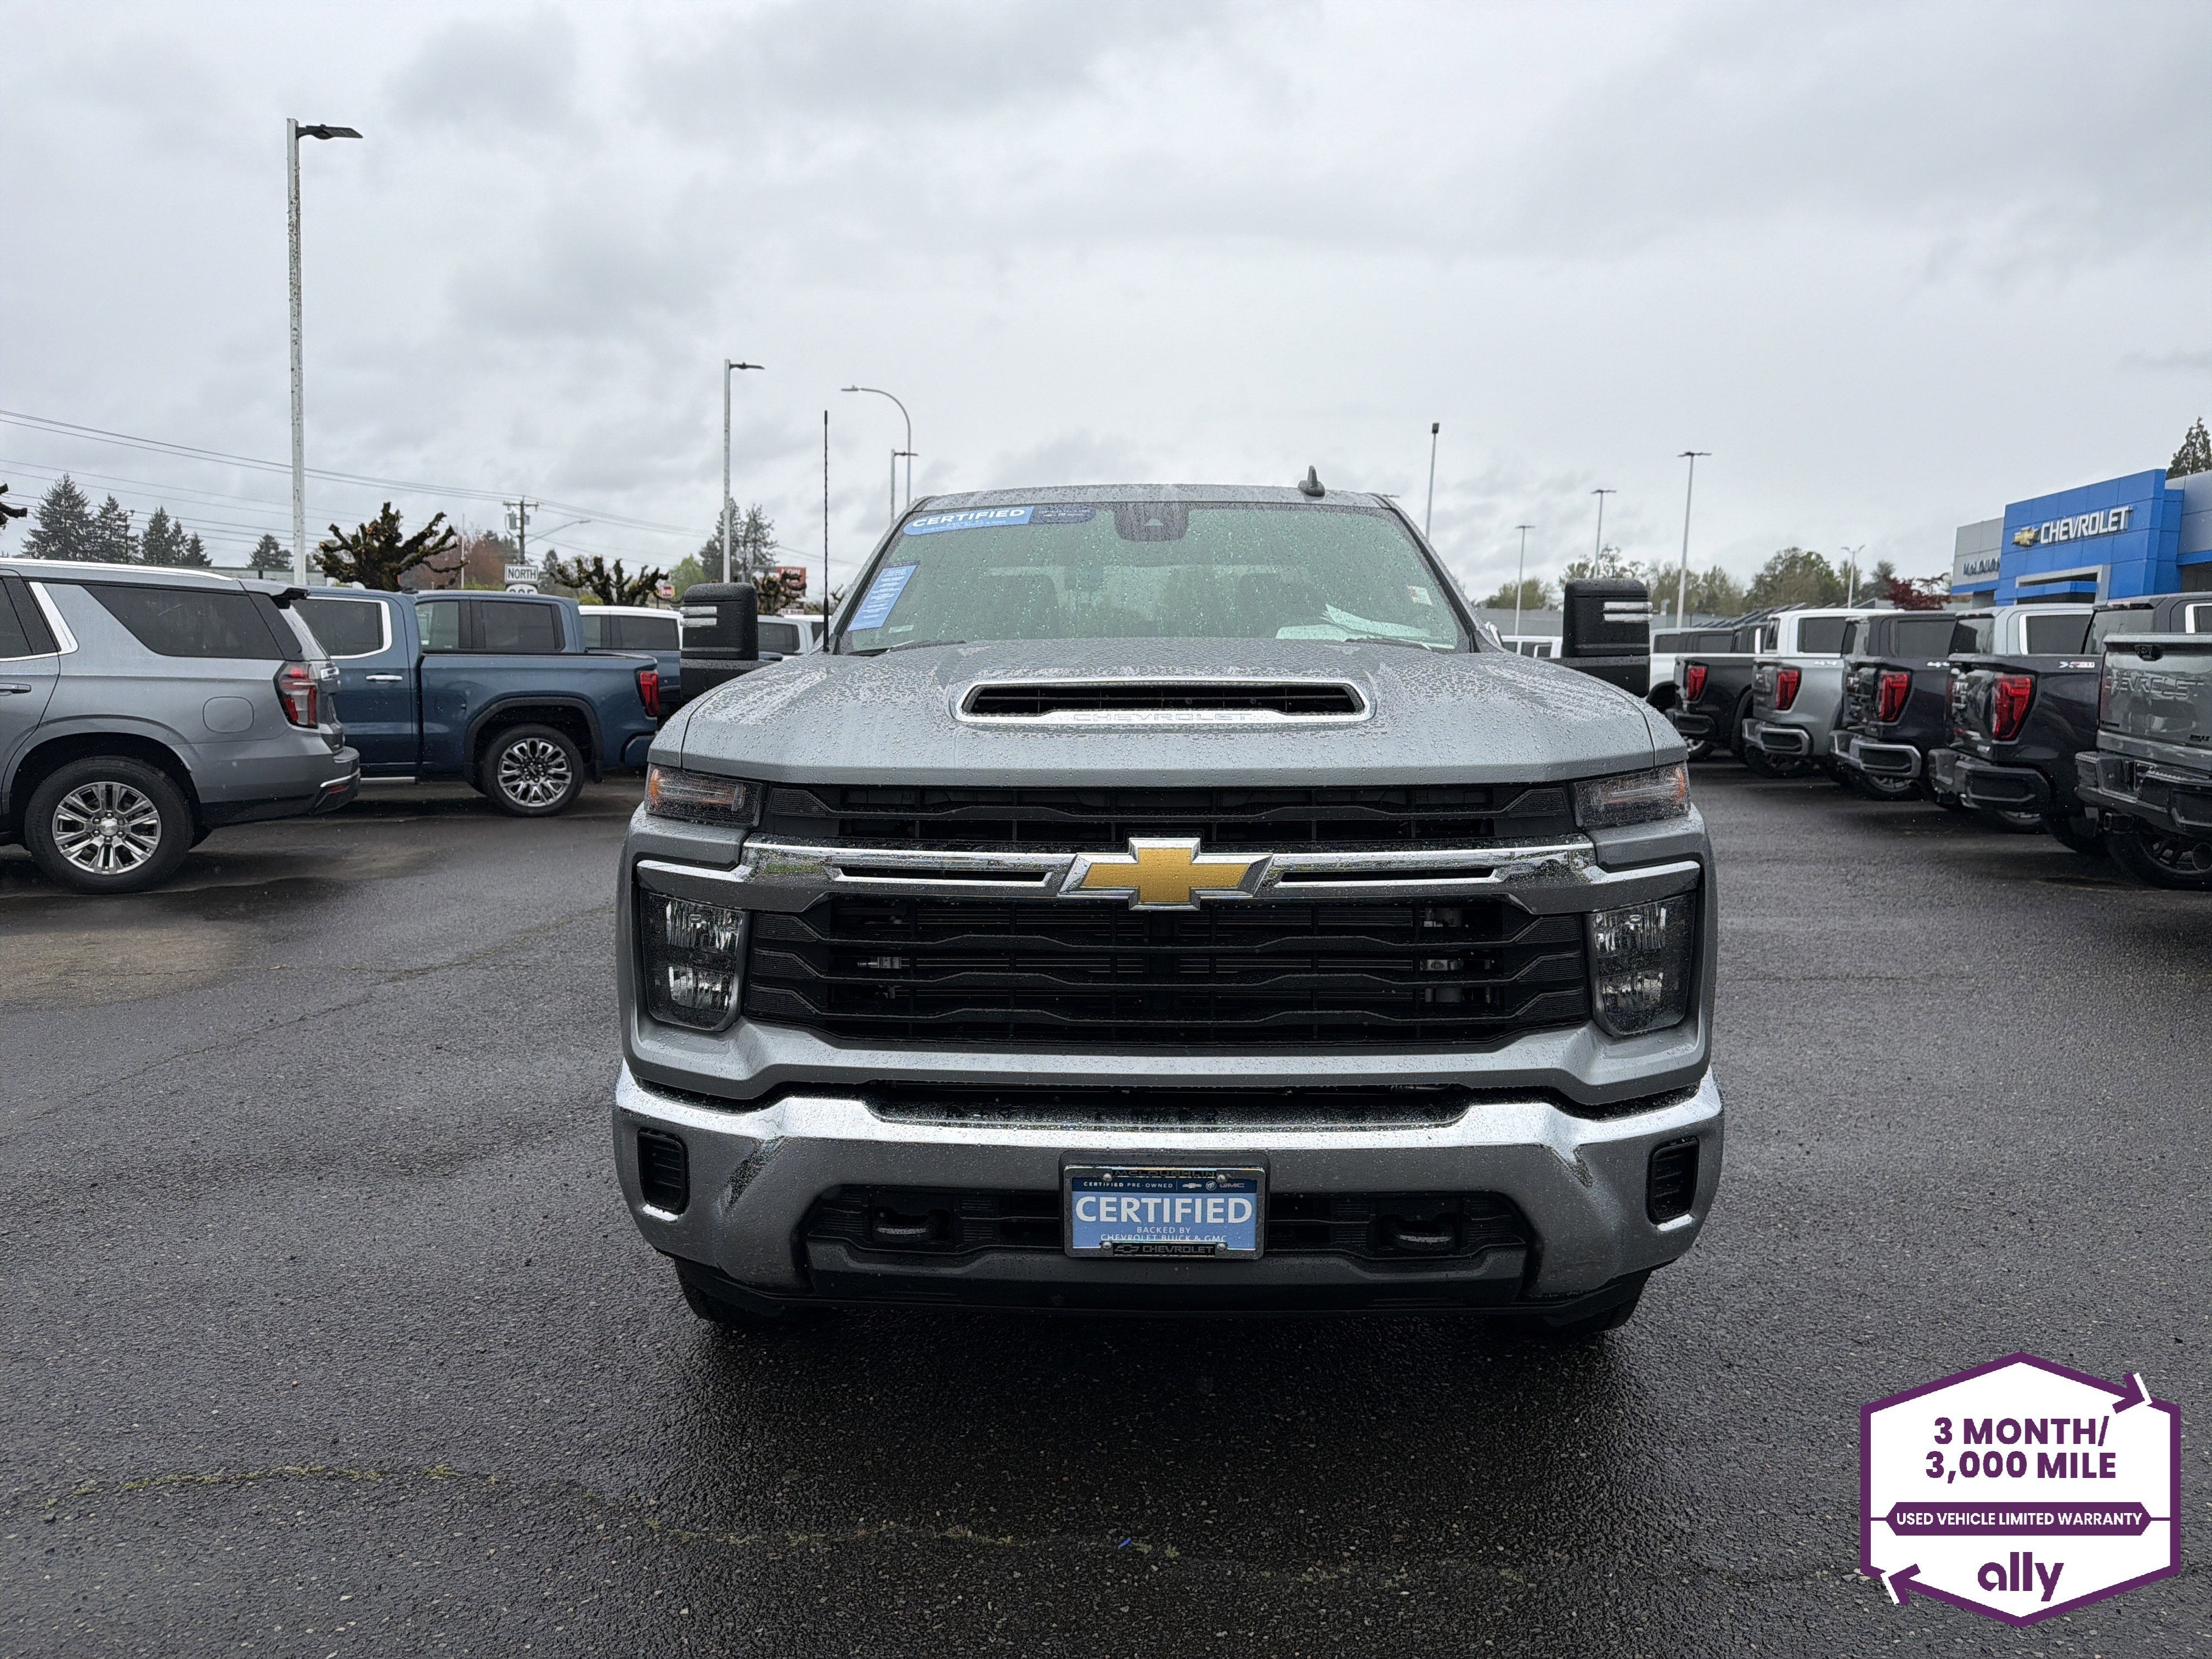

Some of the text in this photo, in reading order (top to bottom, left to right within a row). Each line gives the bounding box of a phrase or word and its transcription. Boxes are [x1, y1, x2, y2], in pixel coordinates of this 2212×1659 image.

[912, 509, 1025, 527] CERTIFIED
[2040, 505, 2130, 544] CHEVROLET
[507, 568, 537, 579] NORTH
[1075, 1196, 1252, 1223] CERTIFIED
[1142, 1245, 1215, 1254] CHEVROLET
